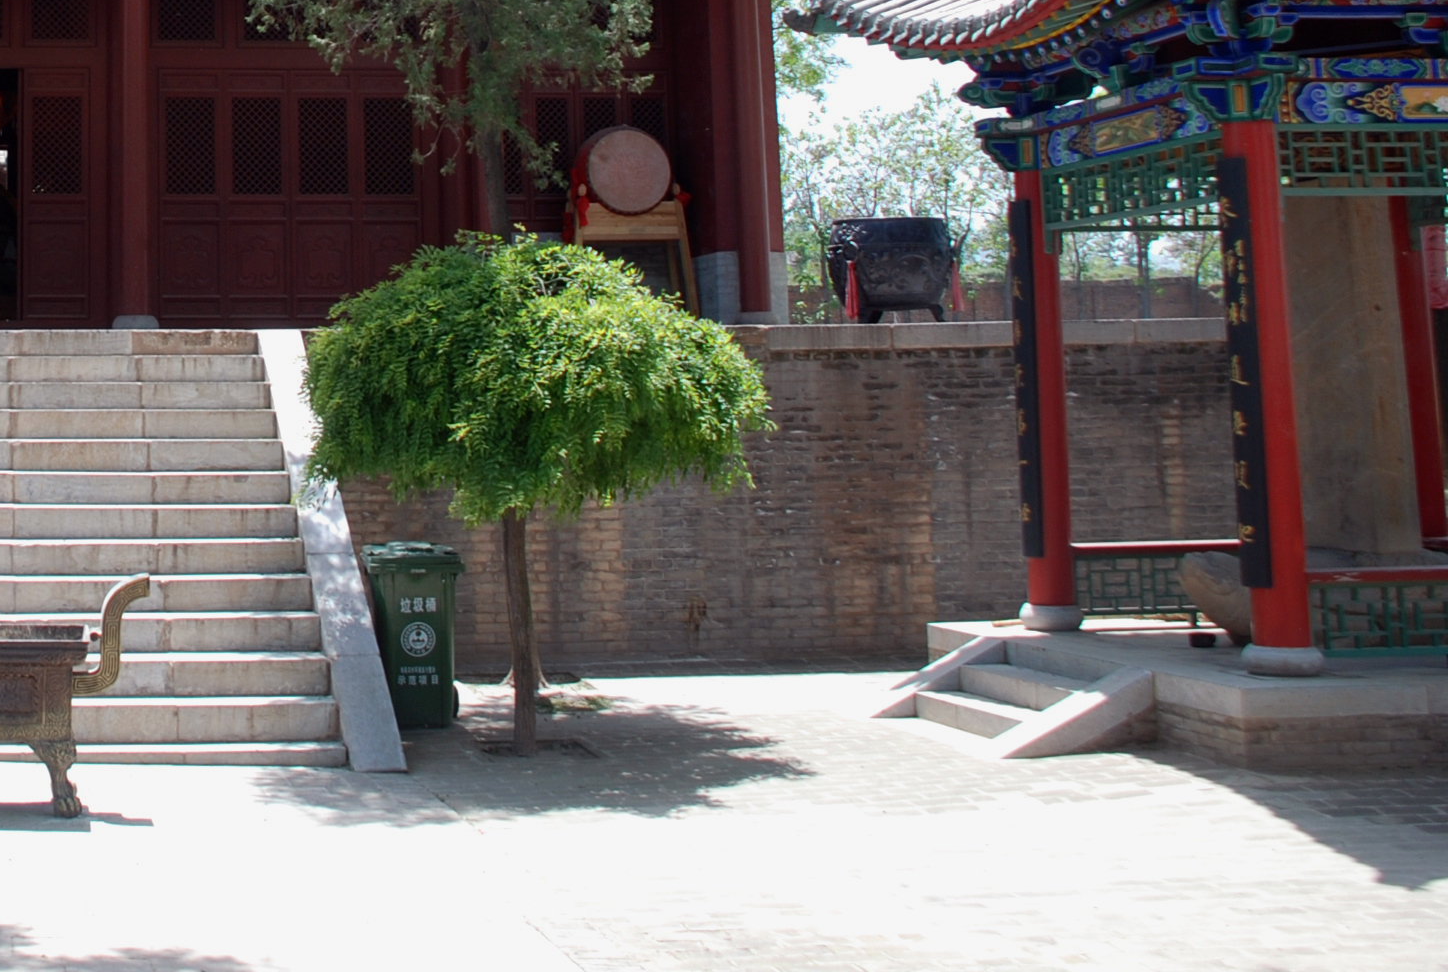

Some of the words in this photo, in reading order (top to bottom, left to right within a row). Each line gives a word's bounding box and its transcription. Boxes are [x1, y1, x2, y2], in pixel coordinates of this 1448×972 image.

[400, 597, 437, 613] 垃圾桶
[397, 674, 439, 685] 示范项目
